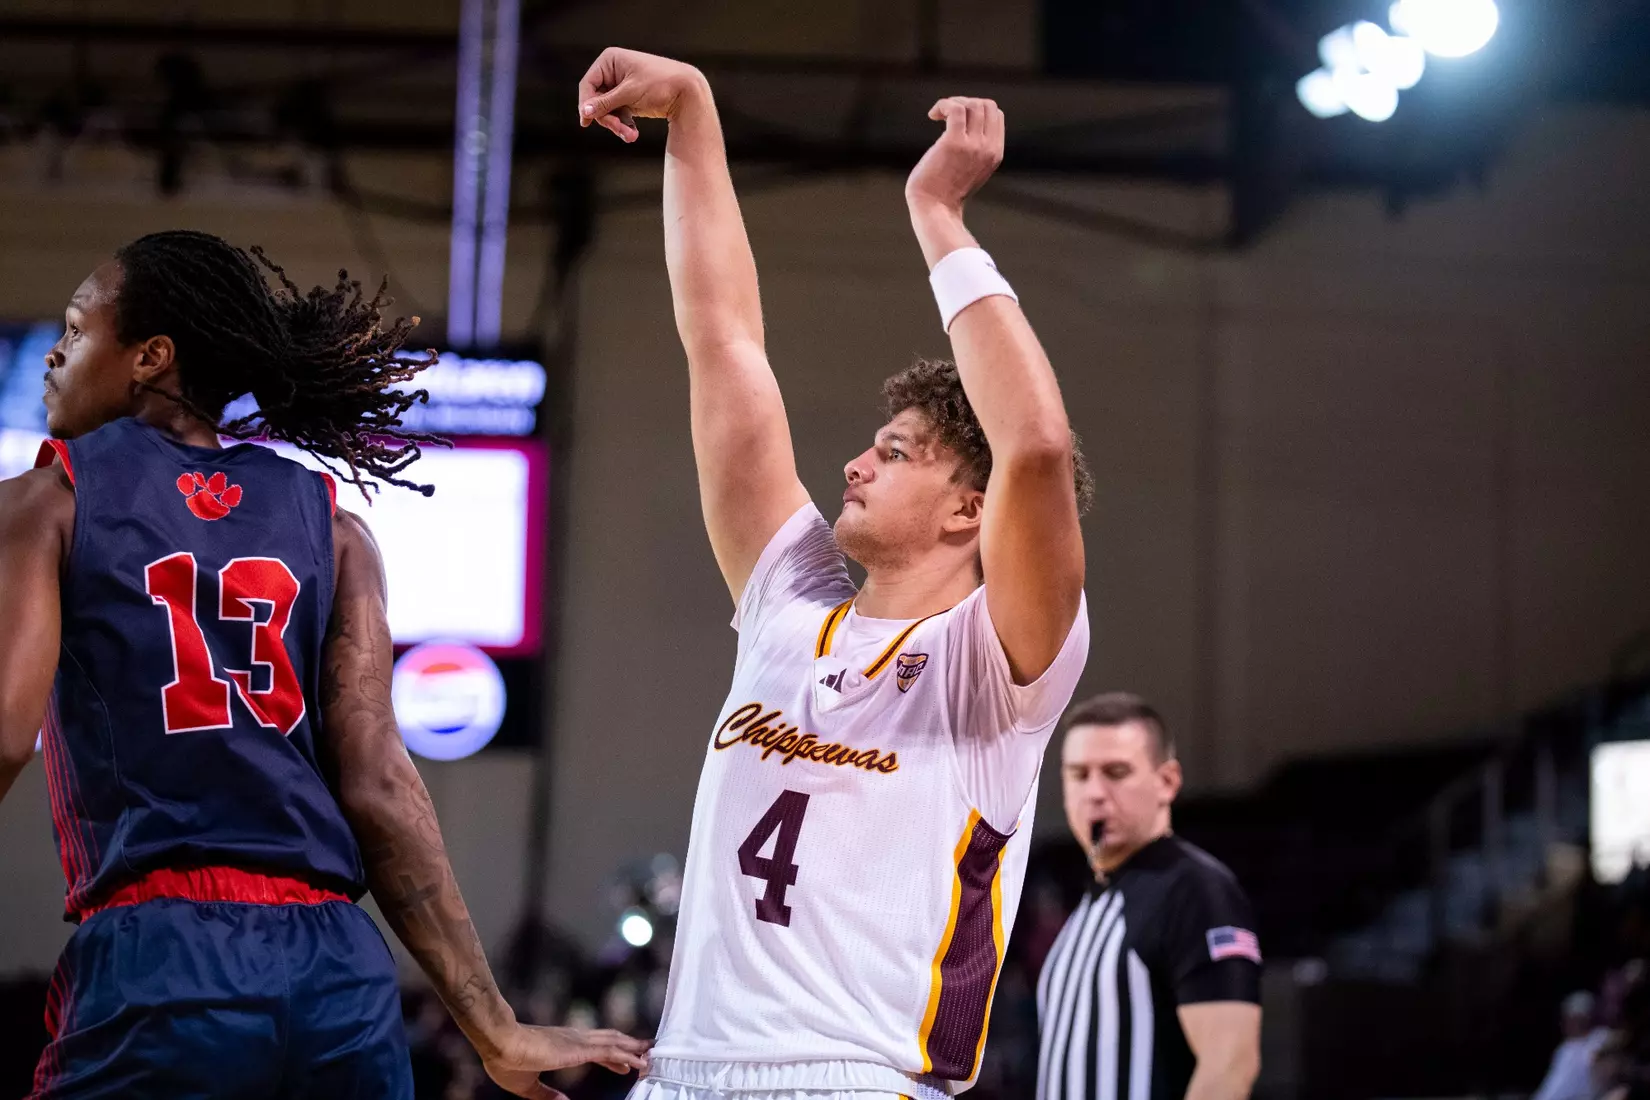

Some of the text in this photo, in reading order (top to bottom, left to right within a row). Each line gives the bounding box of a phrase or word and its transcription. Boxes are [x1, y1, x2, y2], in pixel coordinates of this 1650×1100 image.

[144, 552, 306, 737] 13
[714, 702, 899, 774] Chippewas
[737, 789, 811, 928] 4
